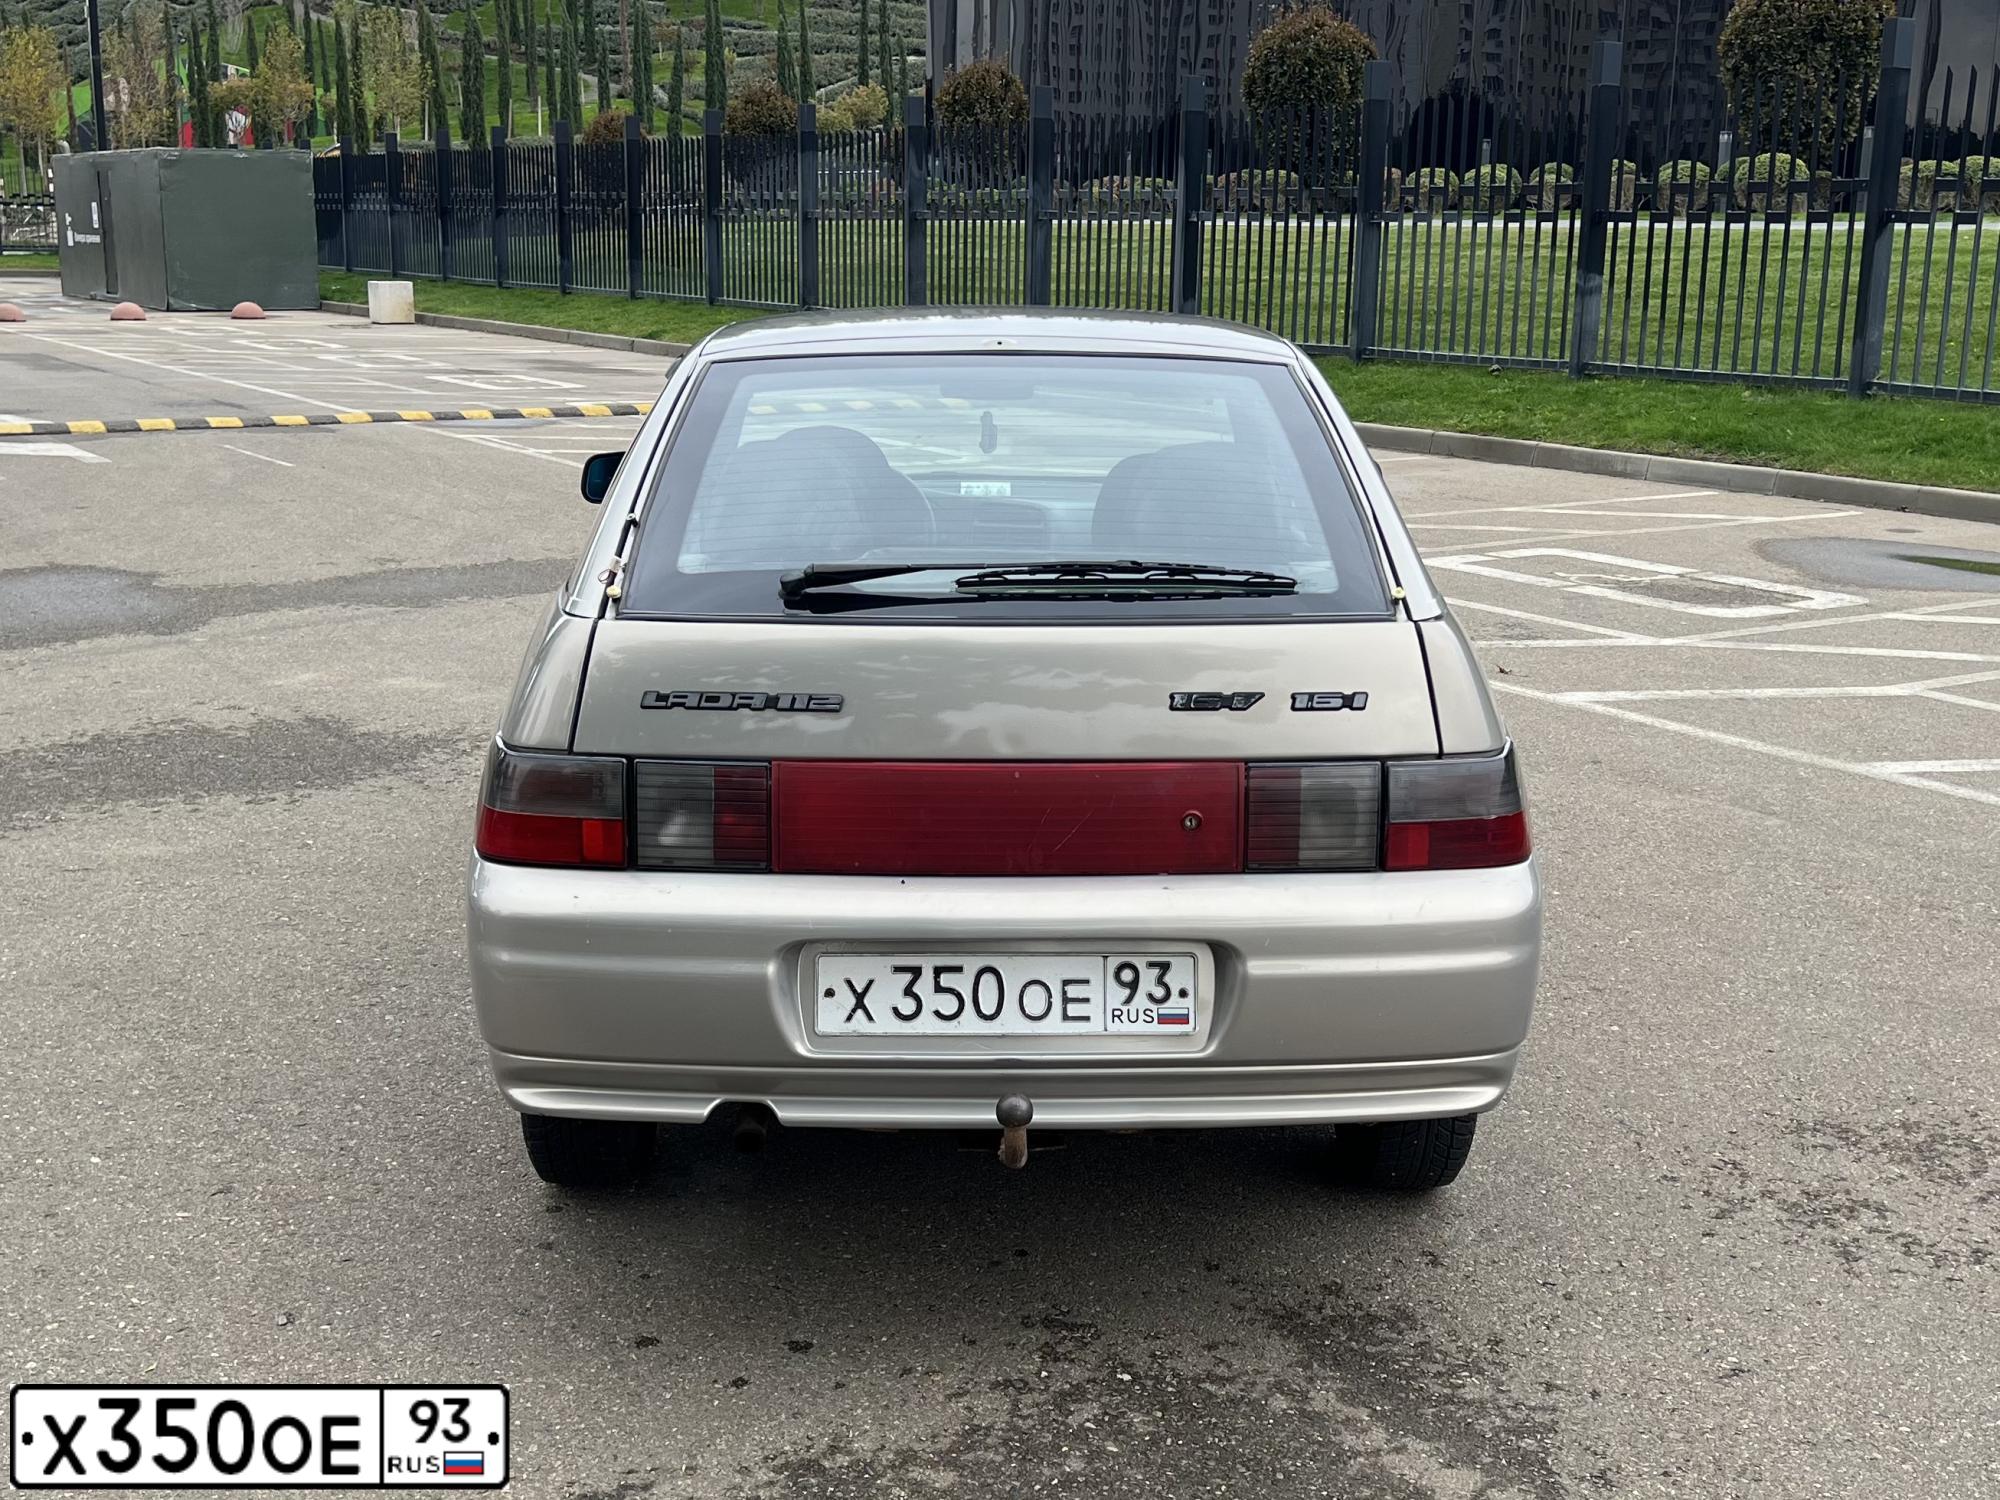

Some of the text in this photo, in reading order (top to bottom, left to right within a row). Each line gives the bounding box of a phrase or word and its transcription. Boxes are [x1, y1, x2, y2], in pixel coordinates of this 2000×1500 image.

[641, 690, 845, 713] LADA 112
[1113, 960, 1173, 1007] 93
[1111, 1007, 1155, 1024] RUS
